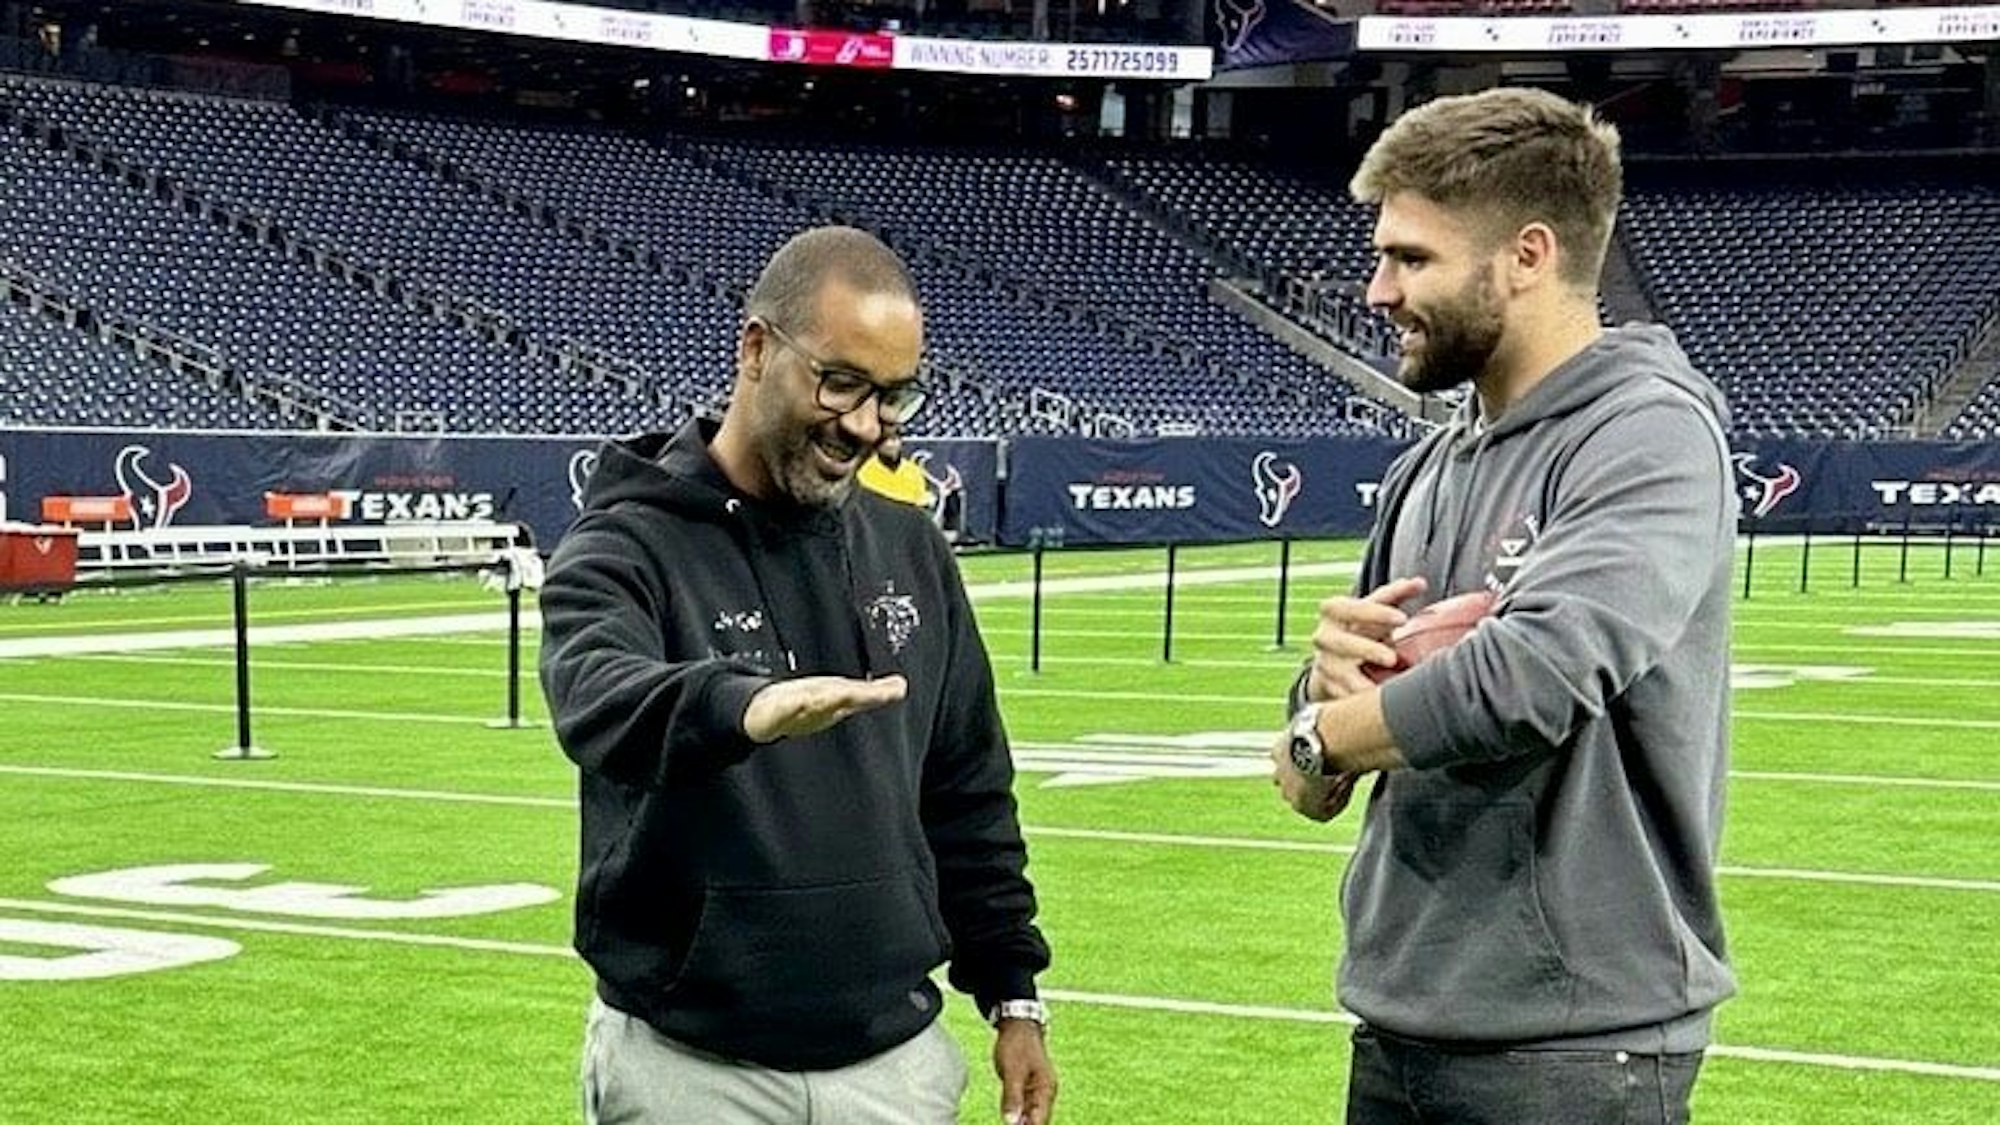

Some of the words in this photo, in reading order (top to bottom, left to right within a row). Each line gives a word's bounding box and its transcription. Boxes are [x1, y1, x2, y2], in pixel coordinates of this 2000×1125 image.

[1067, 50, 1178, 72] 2571725099
[329, 490, 493, 520] TEXANS
[1068, 484, 1195, 509] TEXANS
